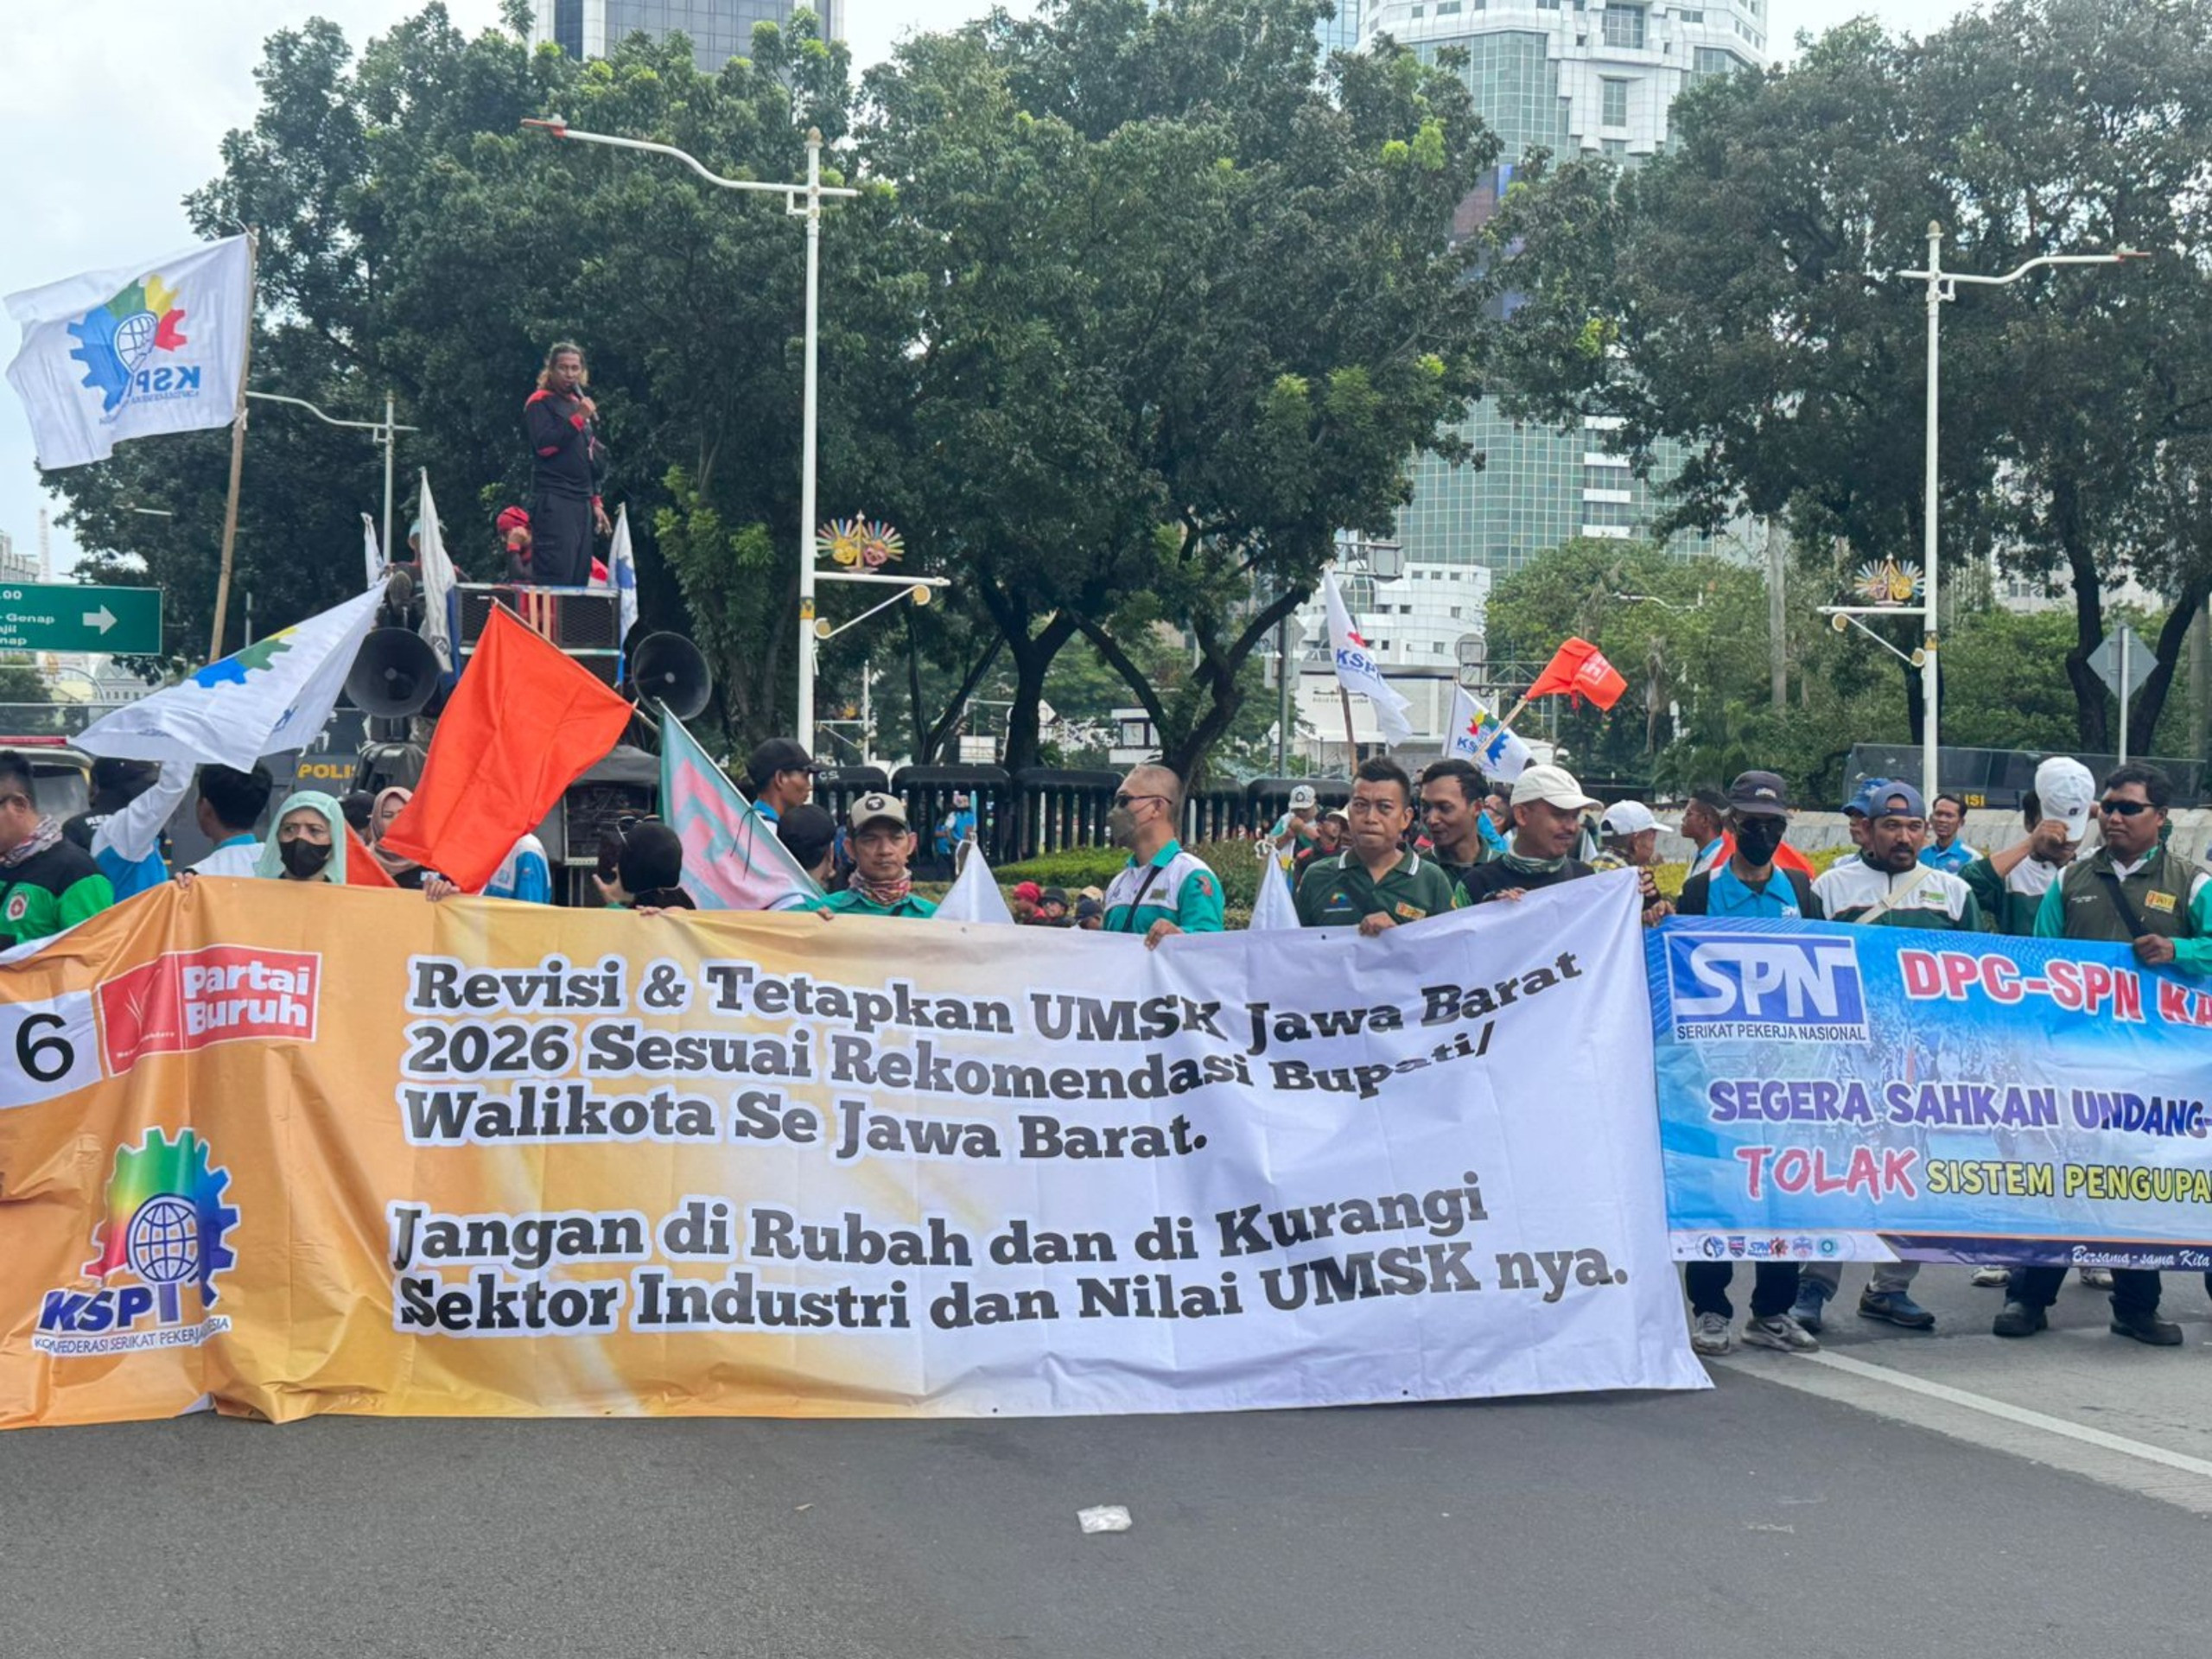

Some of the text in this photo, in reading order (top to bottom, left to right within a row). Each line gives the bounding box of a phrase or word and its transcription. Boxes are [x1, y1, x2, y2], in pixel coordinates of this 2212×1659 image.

[5, 613, 55, 626] Genap
[297, 763, 355, 779] POLI
[182, 960, 311, 1000] Partai
[412, 950, 1583, 1056] Revisi & Tetapkan UMSK Jawa Barat
[1675, 942, 1856, 1018] SPN
[1900, 950, 2143, 1020] DPC-SPN
[185, 995, 308, 1036] Buruh
[1677, 1023, 1866, 1041] SERIKAT PEKERJA NASIONAL
[16, 1013, 75, 1083] 6
[408, 1020, 1496, 1100] 2026 Sesuai Rekomendasi Bupati/
[404, 1085, 1208, 1160] Walikota Se Jawa Barat.
[1708, 1079, 2212, 1139] SEGERA SAHKAN UNDANG-
[1736, 1147, 1917, 1201] TOLAK
[1926, 1159, 2212, 1203] SISTEM PENGUPA
[393, 1170, 1489, 1272] Jangan di Rubah dan di Kurangi
[2178, 1249, 2210, 1268] Kita
[39, 1282, 180, 1332] KSPI
[400, 1242, 1630, 1332] Sektor Industri dan Nilai UMSK nya.
[35, 1326, 204, 1354] KONFEDERASI SERIKAT PEKERJ
